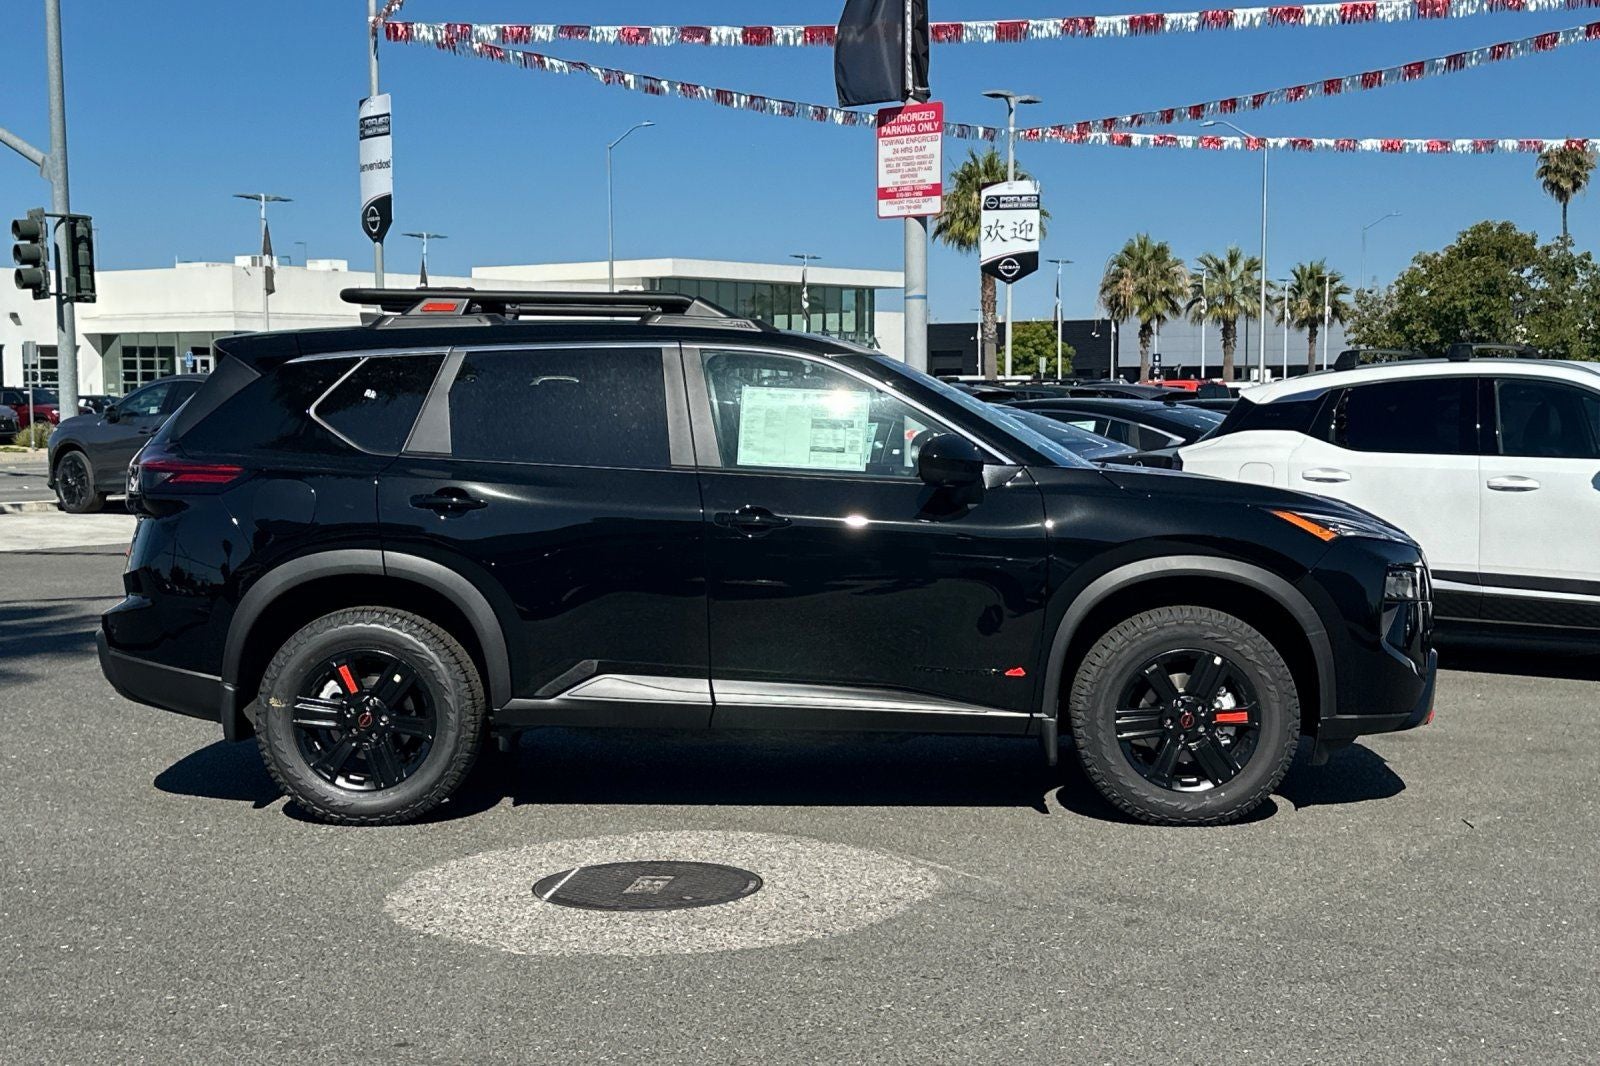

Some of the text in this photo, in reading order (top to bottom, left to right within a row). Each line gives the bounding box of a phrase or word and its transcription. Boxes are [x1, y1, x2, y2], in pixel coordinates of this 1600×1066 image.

[884, 111, 936, 124] AUTHORIZED
[881, 121, 939, 136] PARKING ONLY
[881, 135, 939, 147] TOWING ENFORCED
[892, 145, 927, 155] 24 HRS DAY
[983, 218, 1037, 242] 欢迎
